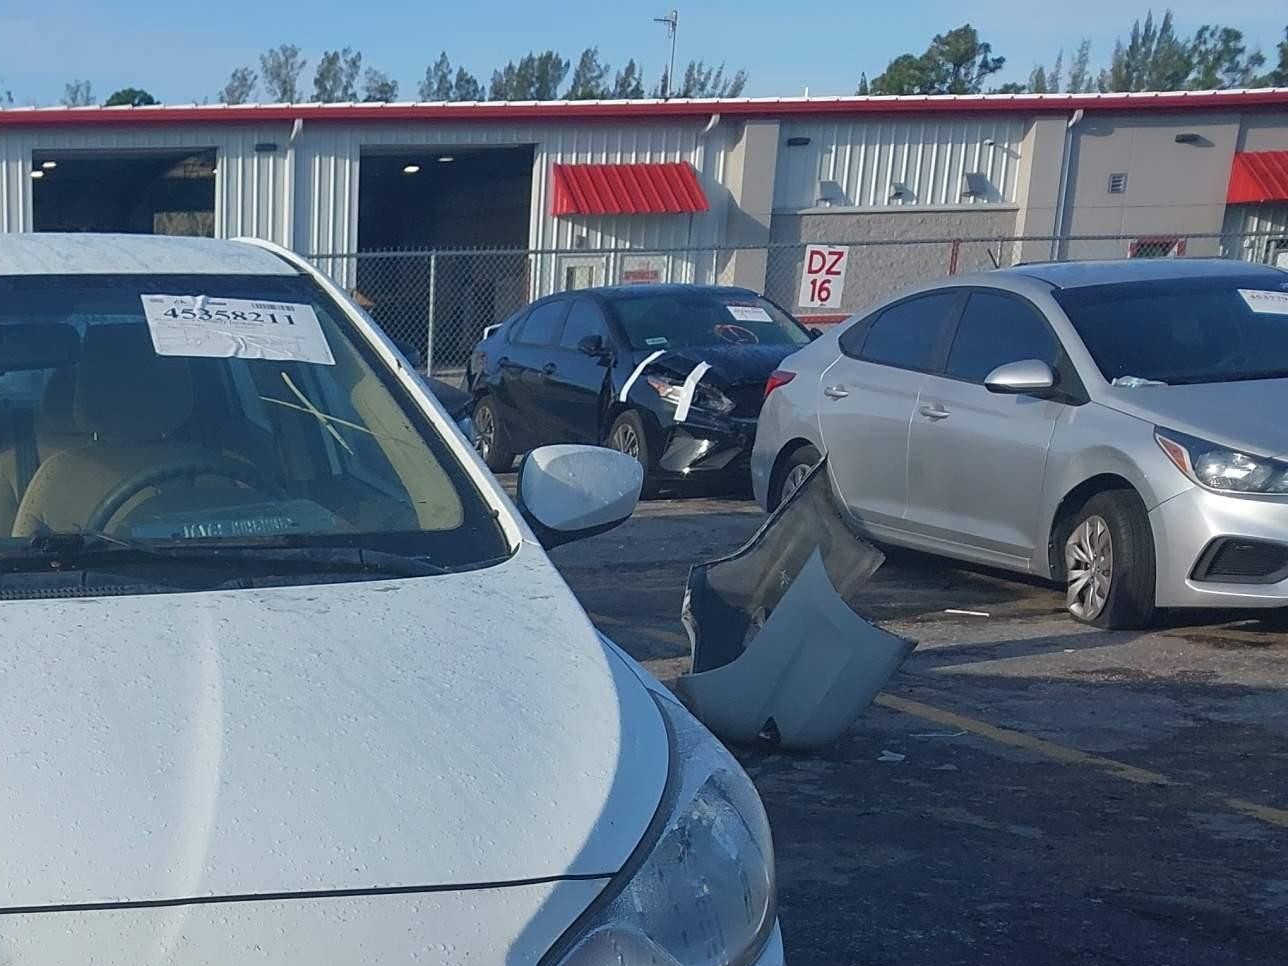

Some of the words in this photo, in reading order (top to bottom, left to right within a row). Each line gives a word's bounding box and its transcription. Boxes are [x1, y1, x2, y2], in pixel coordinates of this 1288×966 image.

[807, 250, 844, 275] DZ
[810, 278, 831, 302] 16
[163, 307, 296, 325] 45358211
